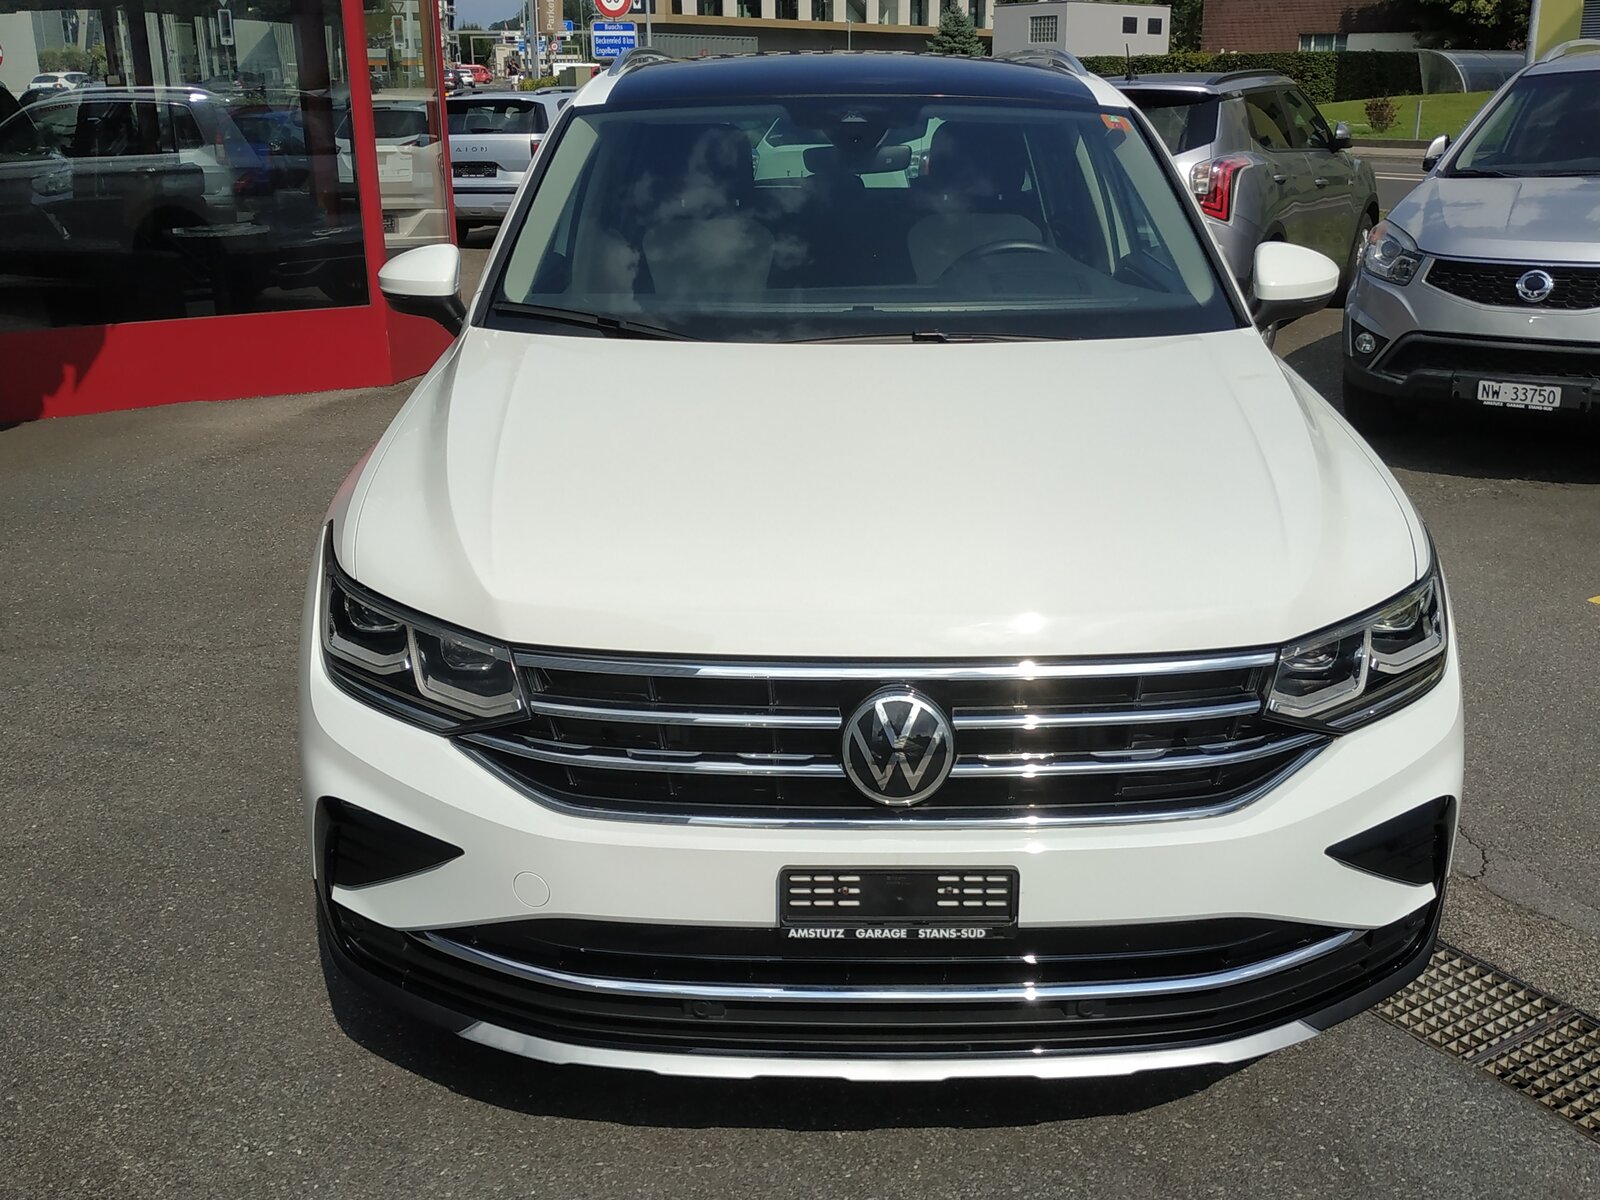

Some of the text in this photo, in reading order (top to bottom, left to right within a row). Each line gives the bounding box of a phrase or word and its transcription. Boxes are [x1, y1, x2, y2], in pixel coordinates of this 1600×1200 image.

[595, 36, 621, 45] Beckenried
[595, 46, 620, 56] Engelberg
[1481, 384, 1556, 404] NW 33750
[788, 928, 845, 938] AMSTUTZ
[855, 928, 907, 938] GARAGE
